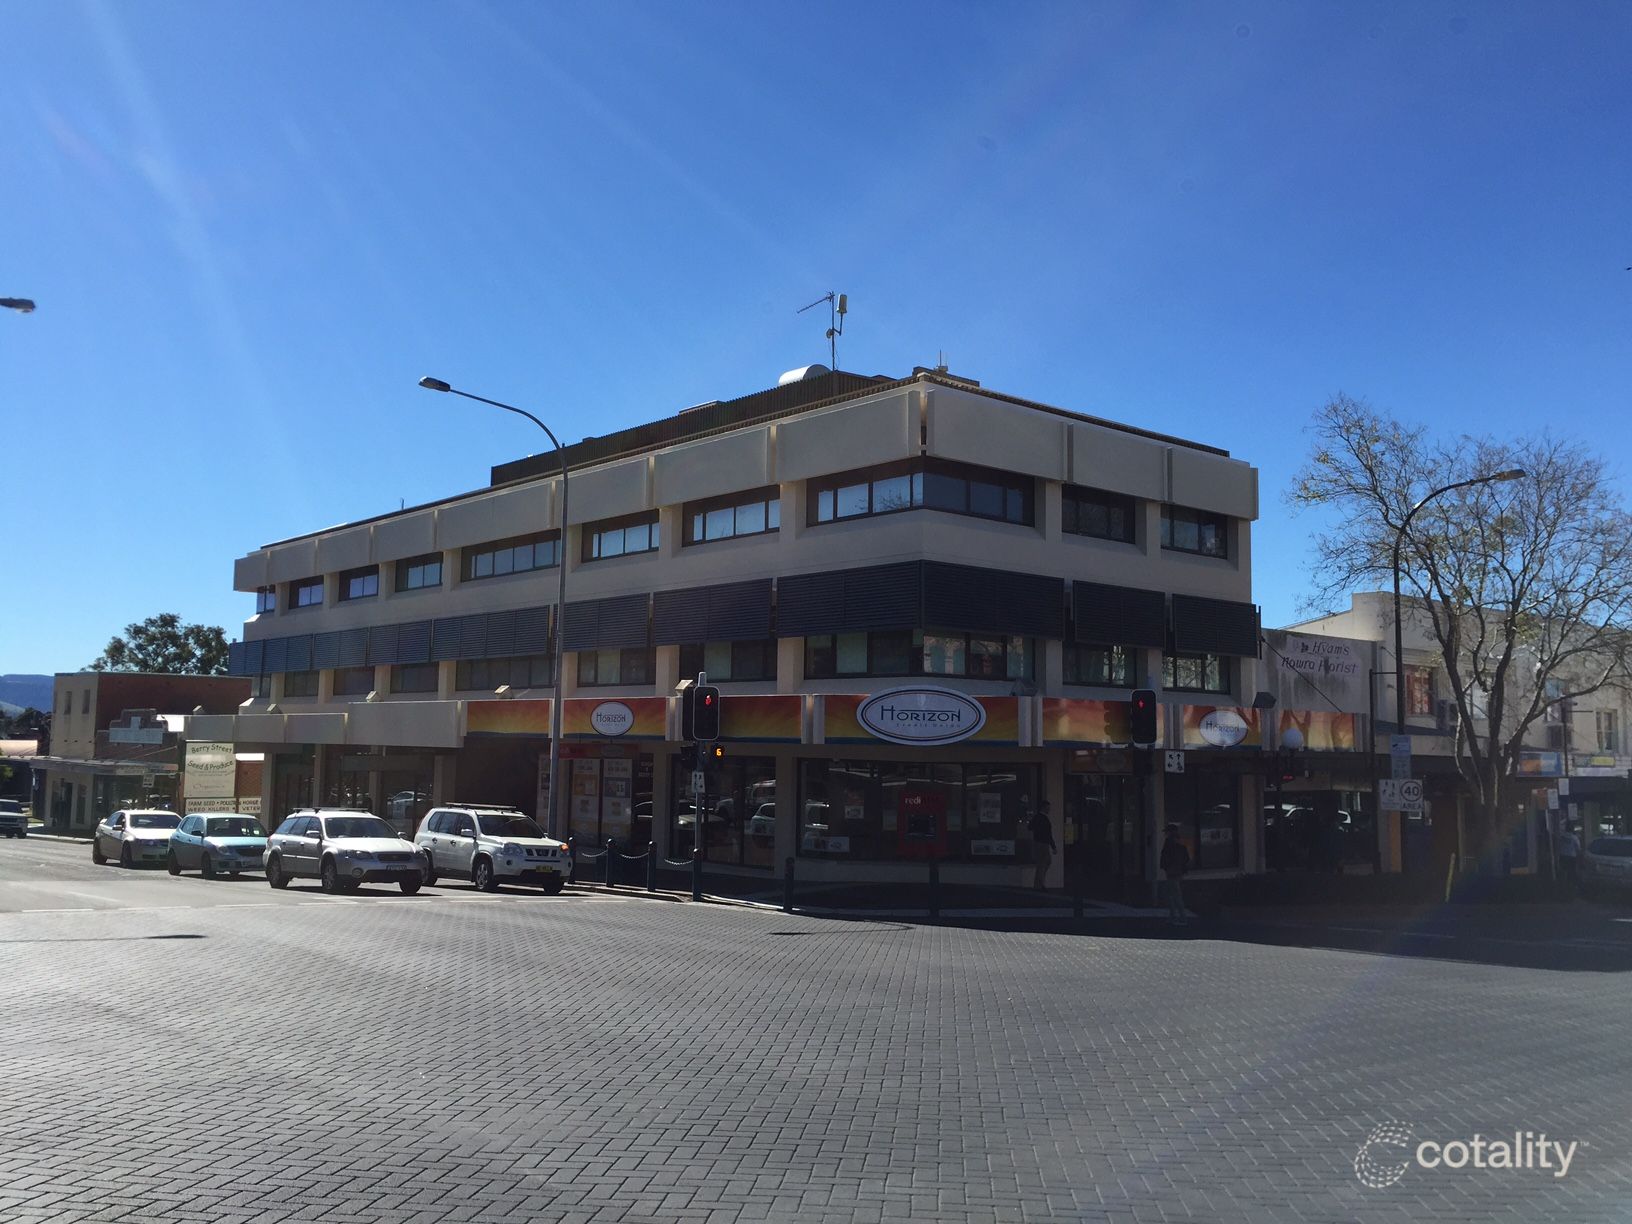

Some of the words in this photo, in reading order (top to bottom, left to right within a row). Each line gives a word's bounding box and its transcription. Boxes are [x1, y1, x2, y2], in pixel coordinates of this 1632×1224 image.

[880, 704, 961, 722] HORIZON
[191, 744, 210, 754] Berry
[211, 743, 232, 753] Street
[716, 747, 722, 757] 6
[1404, 786, 1420, 797] 40
